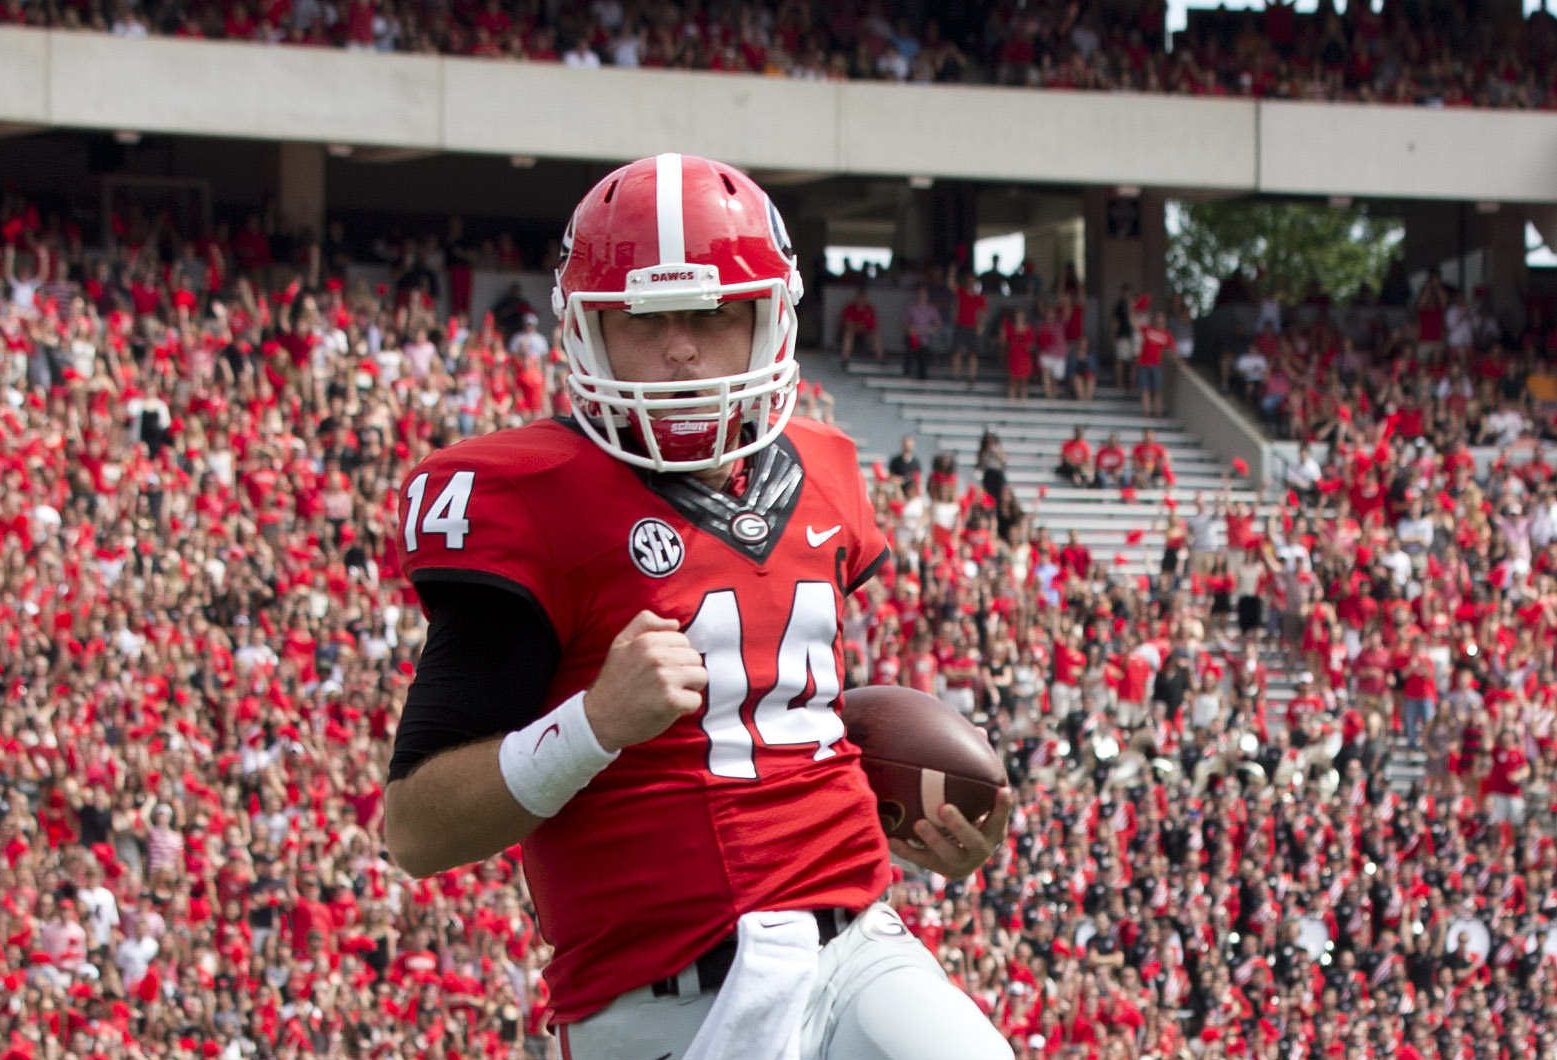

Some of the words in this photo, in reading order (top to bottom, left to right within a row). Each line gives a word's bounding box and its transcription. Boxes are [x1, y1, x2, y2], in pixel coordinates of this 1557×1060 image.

[650, 271, 694, 283] DAWGS
[404, 470, 476, 553] 14
[633, 521, 681, 573] SEC
[683, 579, 845, 779] 14
